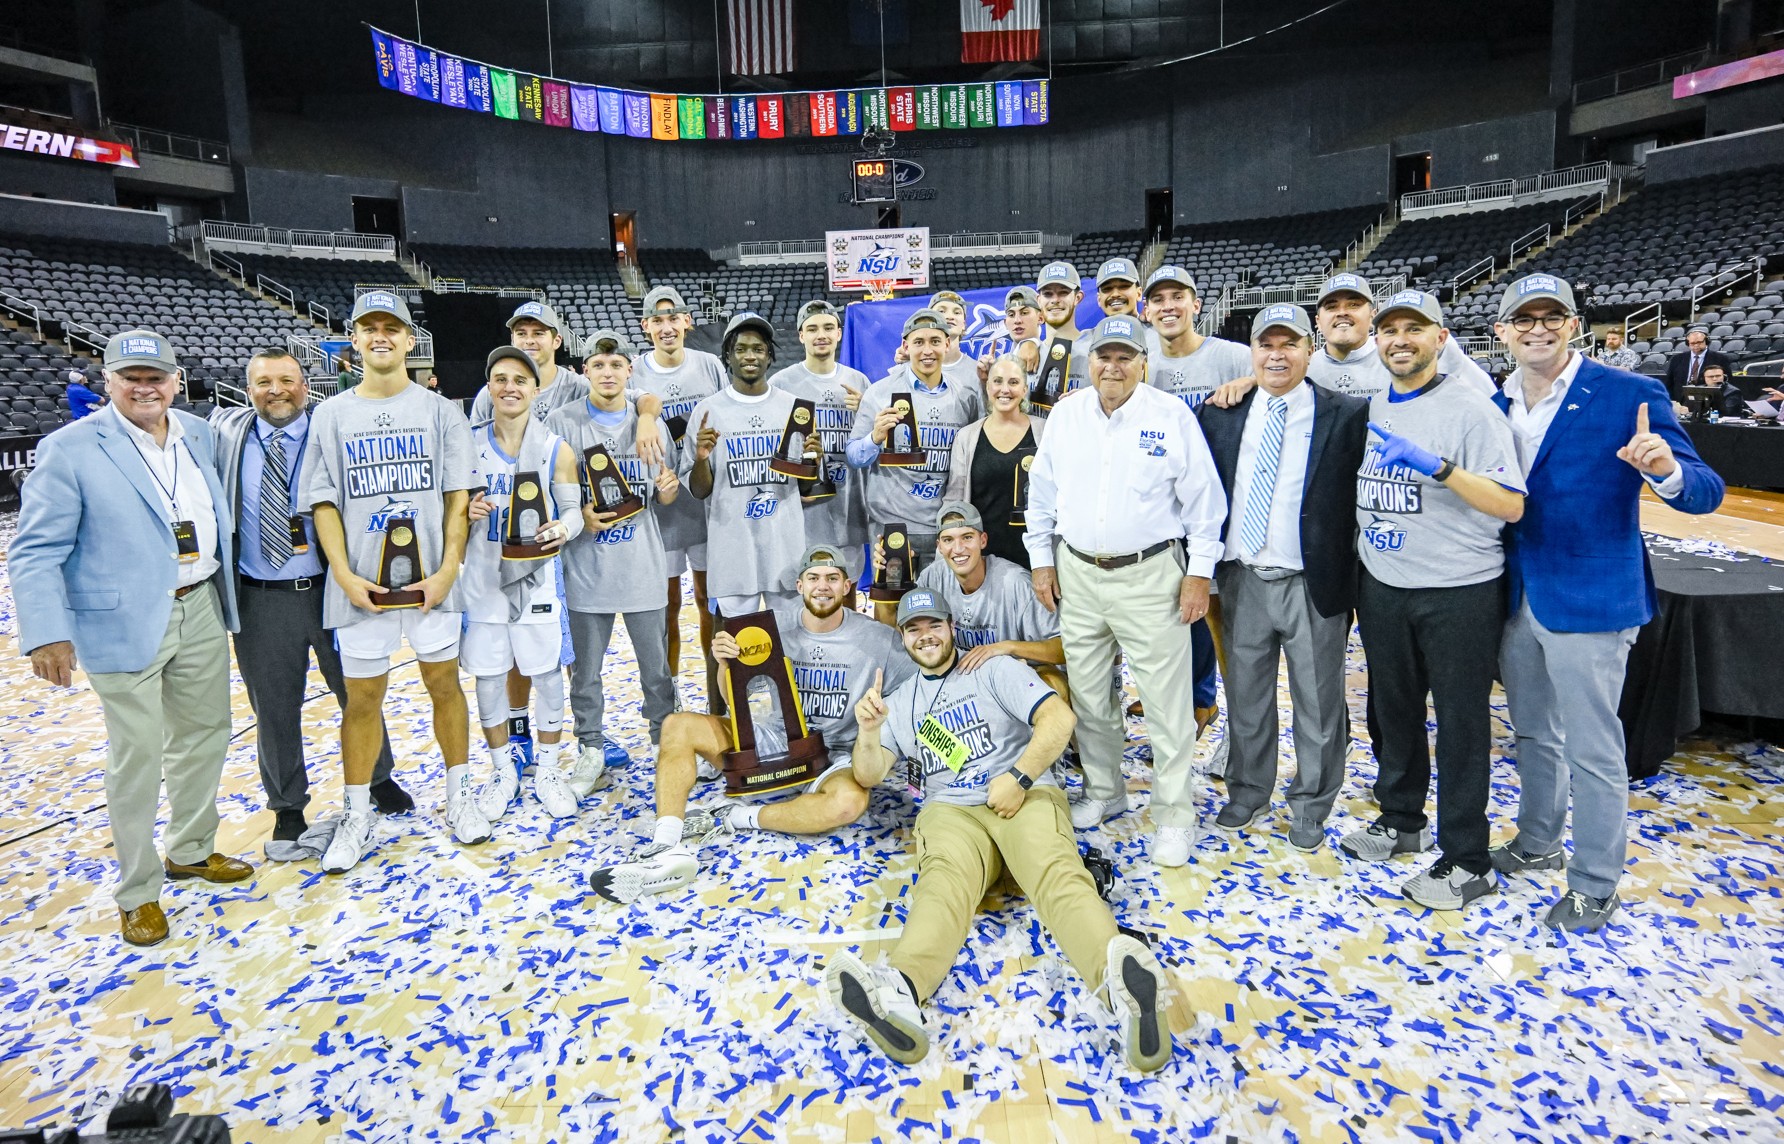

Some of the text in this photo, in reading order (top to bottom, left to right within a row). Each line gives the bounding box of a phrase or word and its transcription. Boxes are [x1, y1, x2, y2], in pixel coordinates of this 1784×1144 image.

[379, 42, 390, 78] DAVIS
[399, 43, 412, 92] WESLEYAN
[422, 62, 431, 84] STATE
[430, 52, 439, 99] METROPOLITAN
[446, 58, 458, 104] WESLEYAN
[454, 59, 466, 105] KENTUCKY
[472, 77, 481, 97] STATE
[480, 66, 491, 112] METROPOLITAN
[525, 85, 534, 109] STATE
[532, 77, 543, 120] KENNESAW
[551, 91, 559, 115] UNION
[560, 89, 568, 119] VIRGINIA
[610, 93, 619, 130] BARTON
[632, 101, 640, 128] STATE
[640, 97, 649, 133] WINONA
[817, 94, 826, 134] SOUTHERN
[827, 97, 835, 129] FLORIDA
[896, 95, 905, 122] STATE
[905, 92, 914, 124] FERRIS
[922, 92, 930, 124] MISSOURI
[931, 87, 939, 128] NORTHWEST
[958, 86, 966, 127] NORTHWEST
[976, 89, 984, 122] MISSOURI
[985, 84, 993, 125] NORTHWEST
[1004, 83, 1012, 125] SOUTHEASTERN
[663, 98, 673, 136] FINDLAY
[686, 98, 695, 135] POMONA
[695, 115, 704, 137] POLY
[717, 98, 726, 138] BELLARMINE
[739, 97, 748, 138] WASHINGTON
[748, 102, 756, 132] WESTERN
[768, 100, 779, 131] DRURY
[857, 256, 901, 274] NSU
[345, 435, 429, 466] NATIONAL
[1140, 430, 1165, 440] NSU
[348, 462, 431, 496] CHAMPIONS
[595, 525, 636, 543] NSU
[741, 641, 771, 658] NCAA
[919, 719, 956, 758] ONSHIPS
[746, 764, 807, 784] NATIONAL CHAMPION
